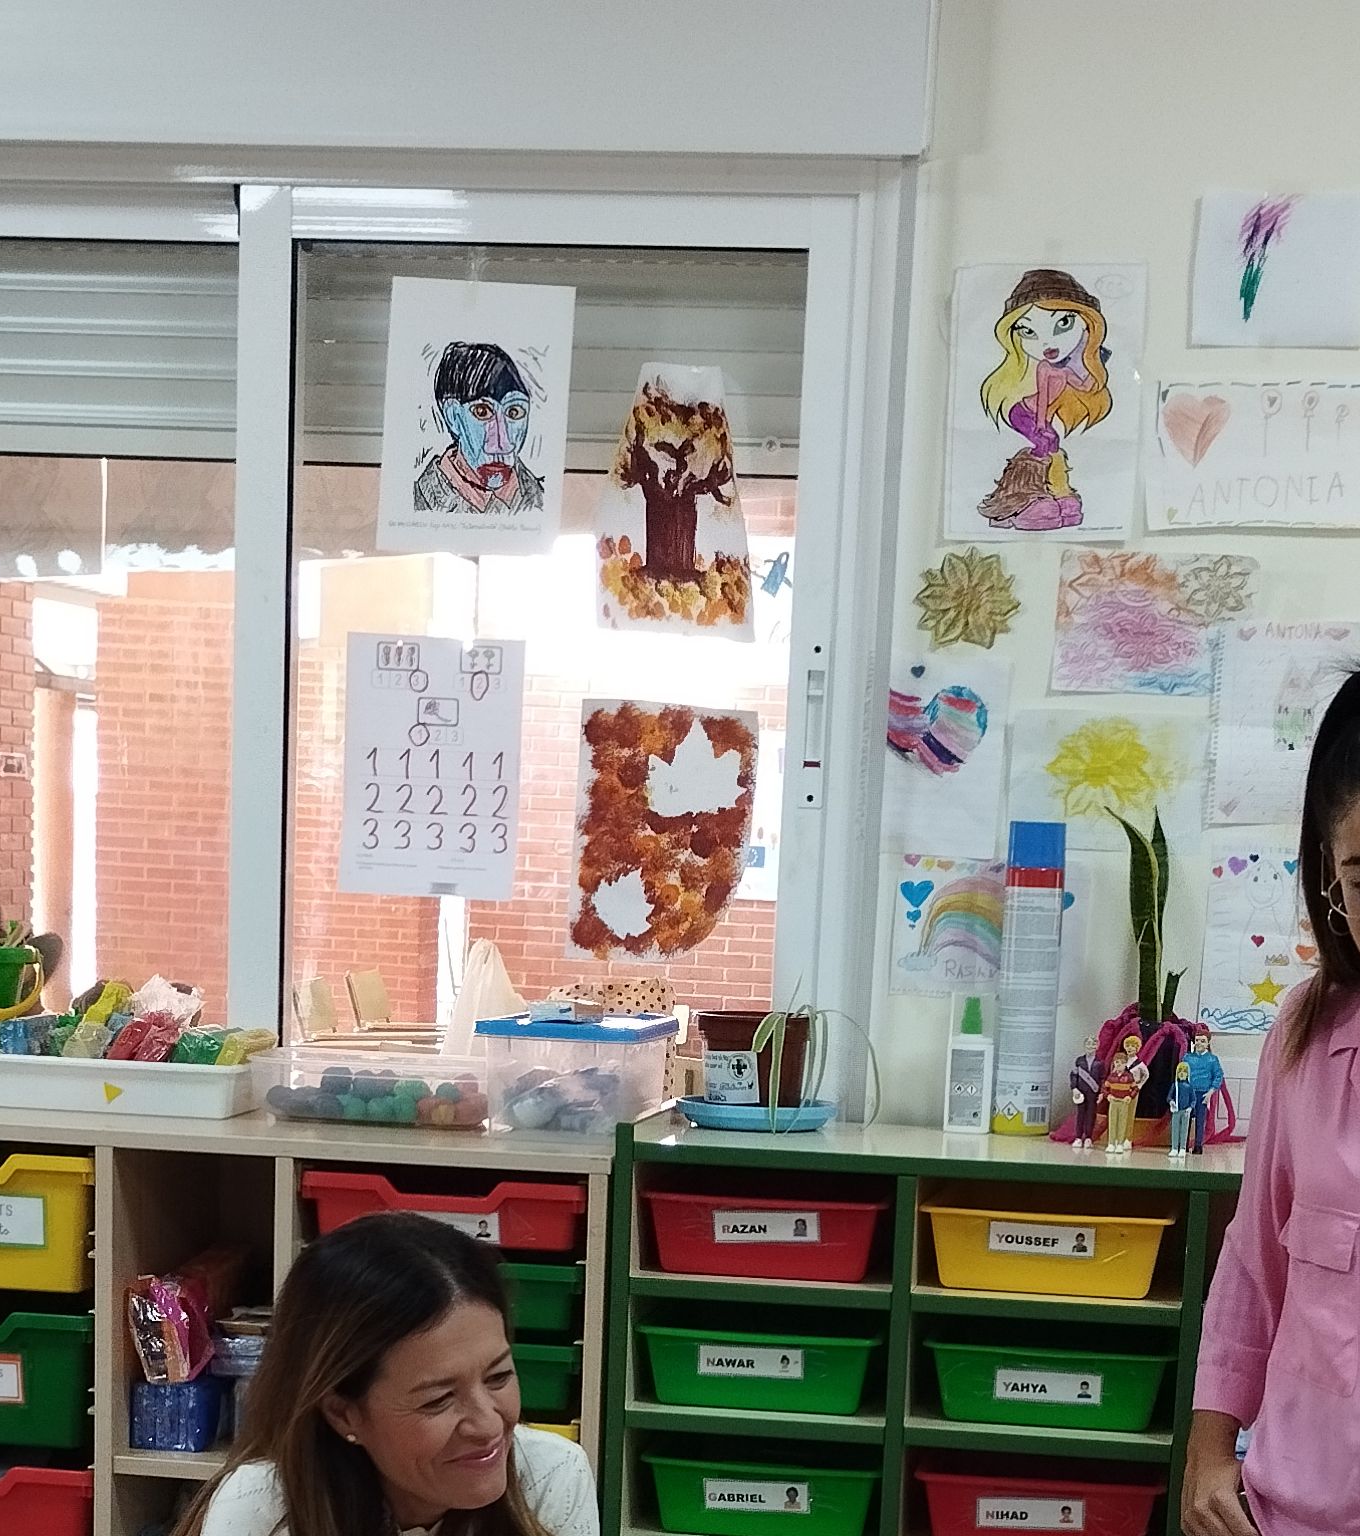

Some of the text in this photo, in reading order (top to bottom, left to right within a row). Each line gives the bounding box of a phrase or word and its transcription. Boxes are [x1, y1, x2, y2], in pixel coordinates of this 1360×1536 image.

[1185, 472, 1346, 517] ANTONIA
[366, 747, 504, 781] 1 1 1 1 1
[365, 782, 510, 819] 2 2 2 2 2
[362, 818, 508, 854] 3 3 3 3 3
[721, 1223, 768, 1235] RAZAN
[996, 1233, 1060, 1248] YOUSSEF
[706, 1357, 756, 1370] NAWAR
[1002, 1381, 1048, 1394] YAHYA
[707, 1492, 766, 1504] GABRIEL
[985, 1509, 1029, 1522] NIHAD
